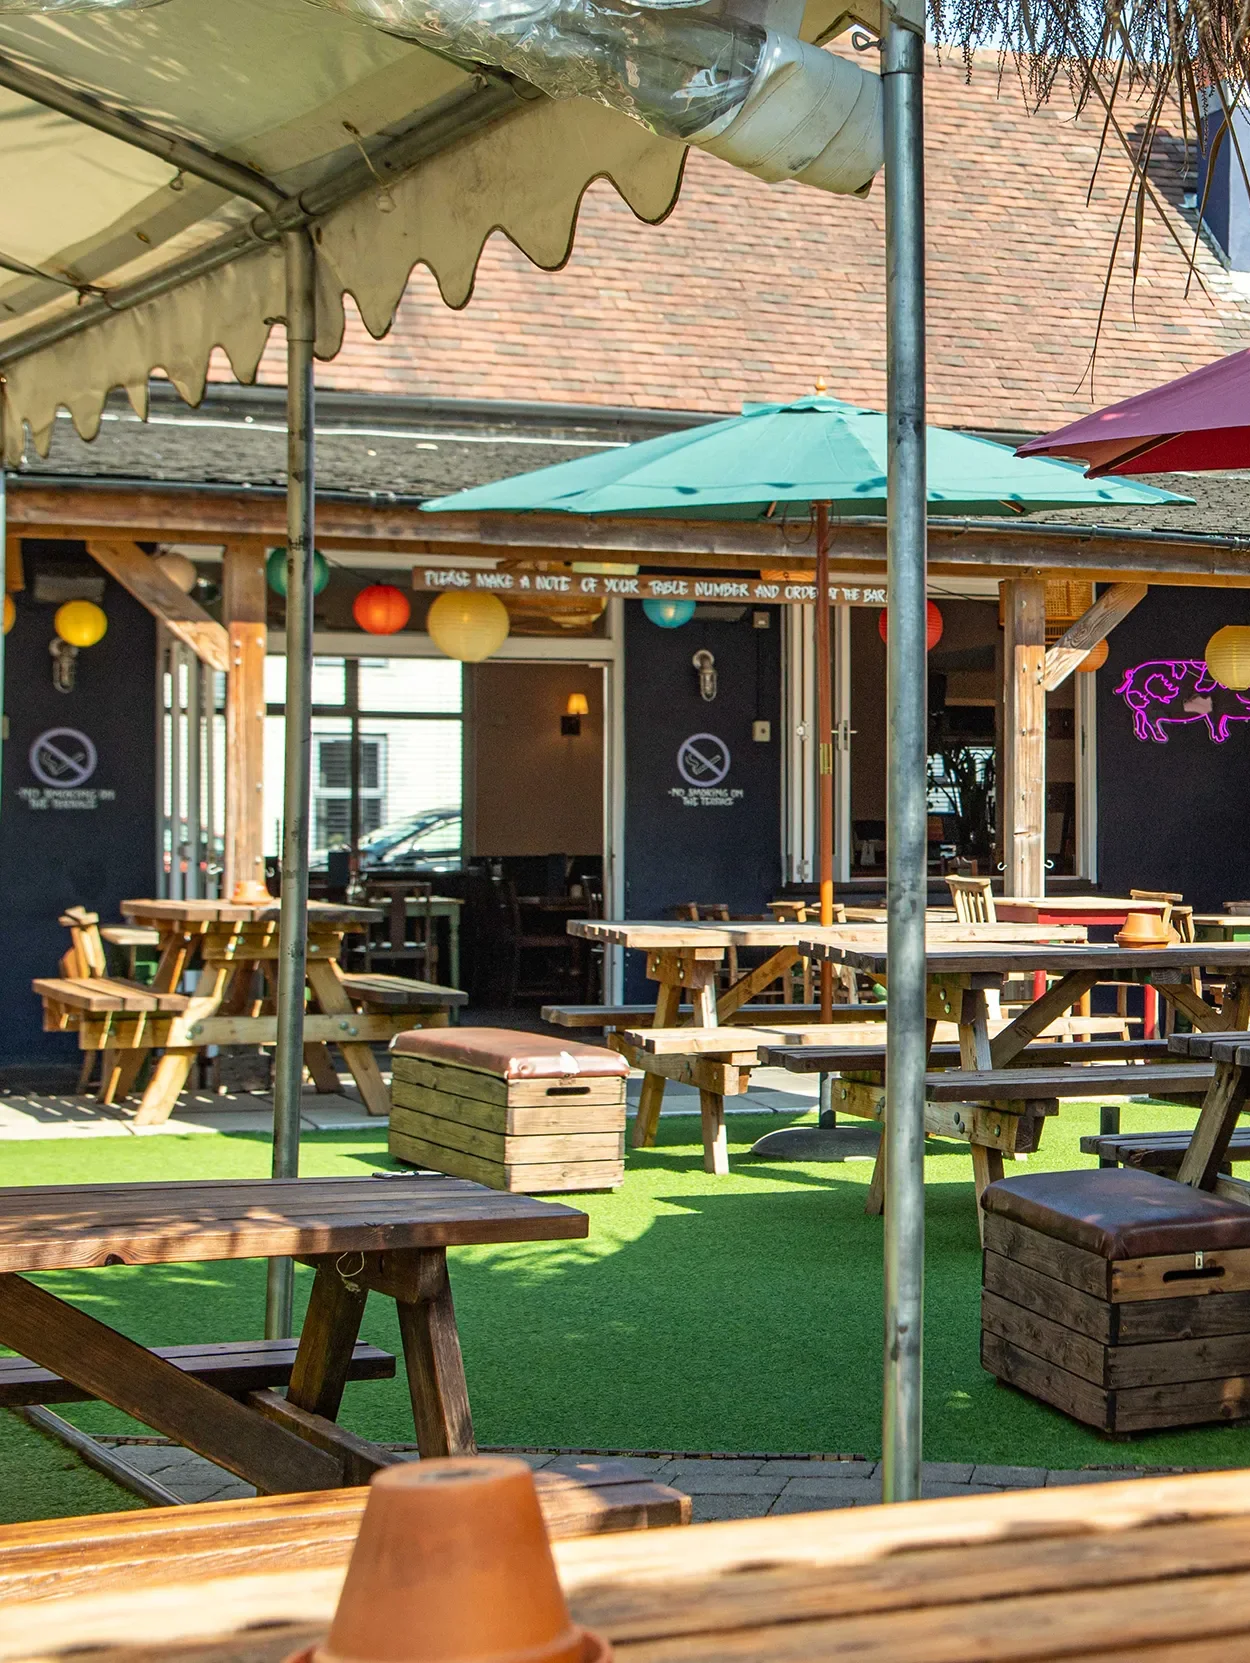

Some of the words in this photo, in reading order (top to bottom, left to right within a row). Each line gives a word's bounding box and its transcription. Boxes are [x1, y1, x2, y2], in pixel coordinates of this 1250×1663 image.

[424, 570, 471, 587] PLEASE
[476, 573, 514, 588] MAKE
[519, 575, 530, 588] A
[536, 575, 571, 591] NOTE
[580, 577, 598, 592] OF
[604, 578, 639, 593] YOUR
[648, 580, 688, 595] TABLE
[695, 582, 749, 596] NUMBER
[754, 584, 780, 598] AND
[784, 586, 819, 599] ORDE
[841, 587, 860, 600] THE
